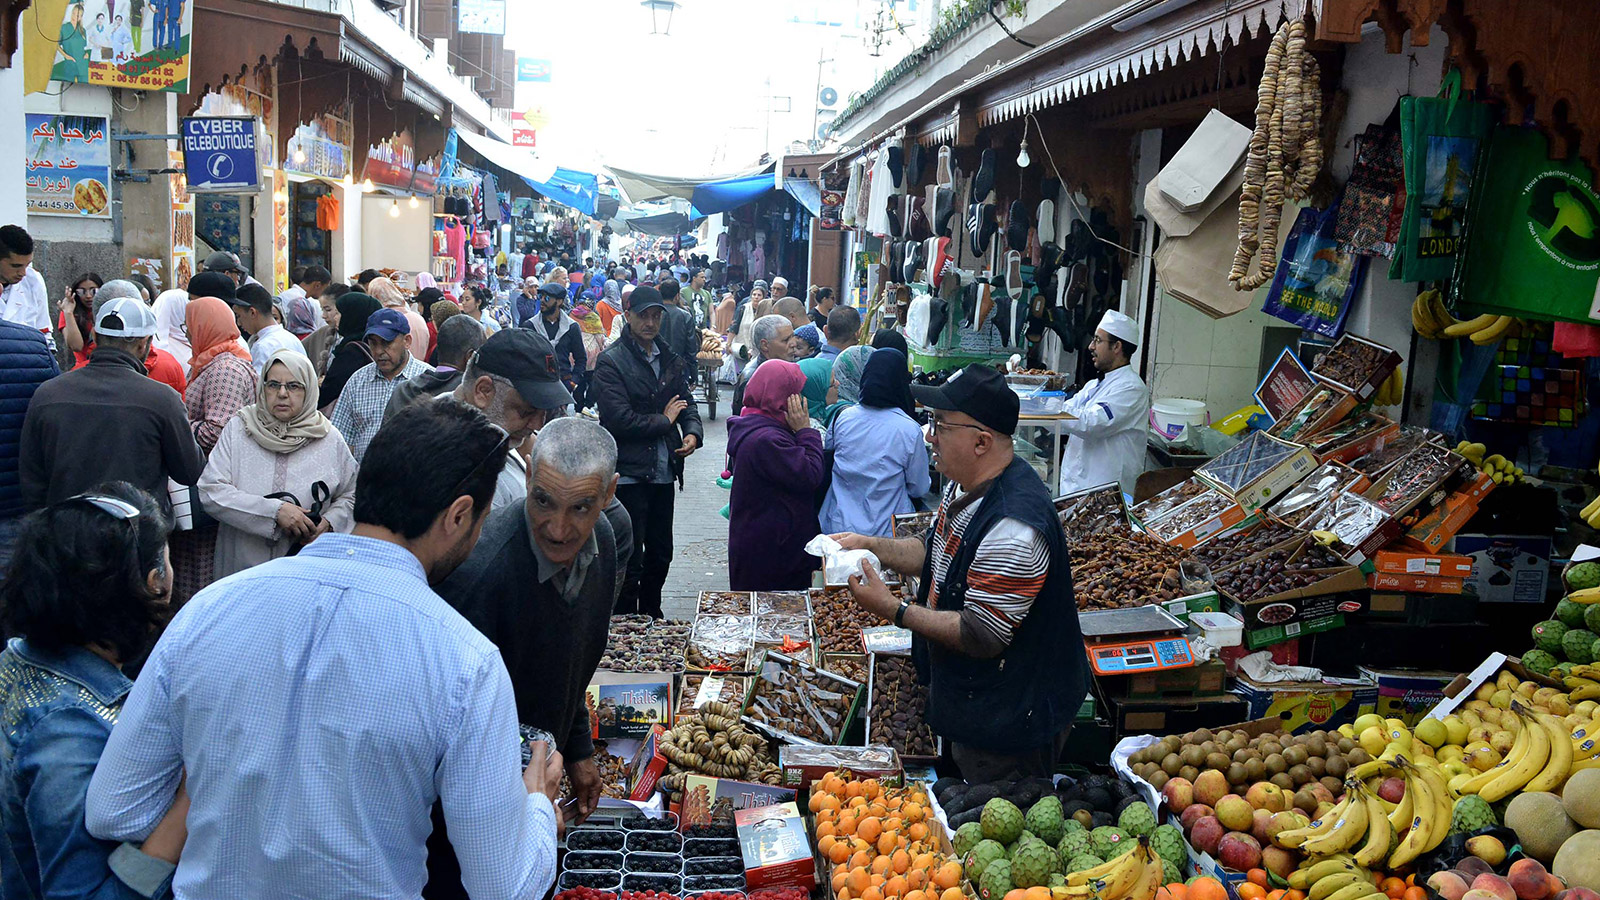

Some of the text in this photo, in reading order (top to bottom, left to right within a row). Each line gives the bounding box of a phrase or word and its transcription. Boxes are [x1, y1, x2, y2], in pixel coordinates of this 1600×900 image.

[32, 122, 103, 144] مرحبا بكم
[189, 120, 243, 134] CYBER
[184, 133, 254, 151] TELEBOUTIQUE
[58, 156, 78, 169] عند
[1570, 173, 1582, 184] pas
[37, 201, 48, 209] 44
[50, 201, 62, 209] 45
[63, 202, 75, 211] 99
[1527, 221, 1537, 236] nous
[1565, 261, 1576, 270] nos
[1281, 289, 1338, 317] SEE THE WORLD
[621, 689, 658, 705] Thalis
